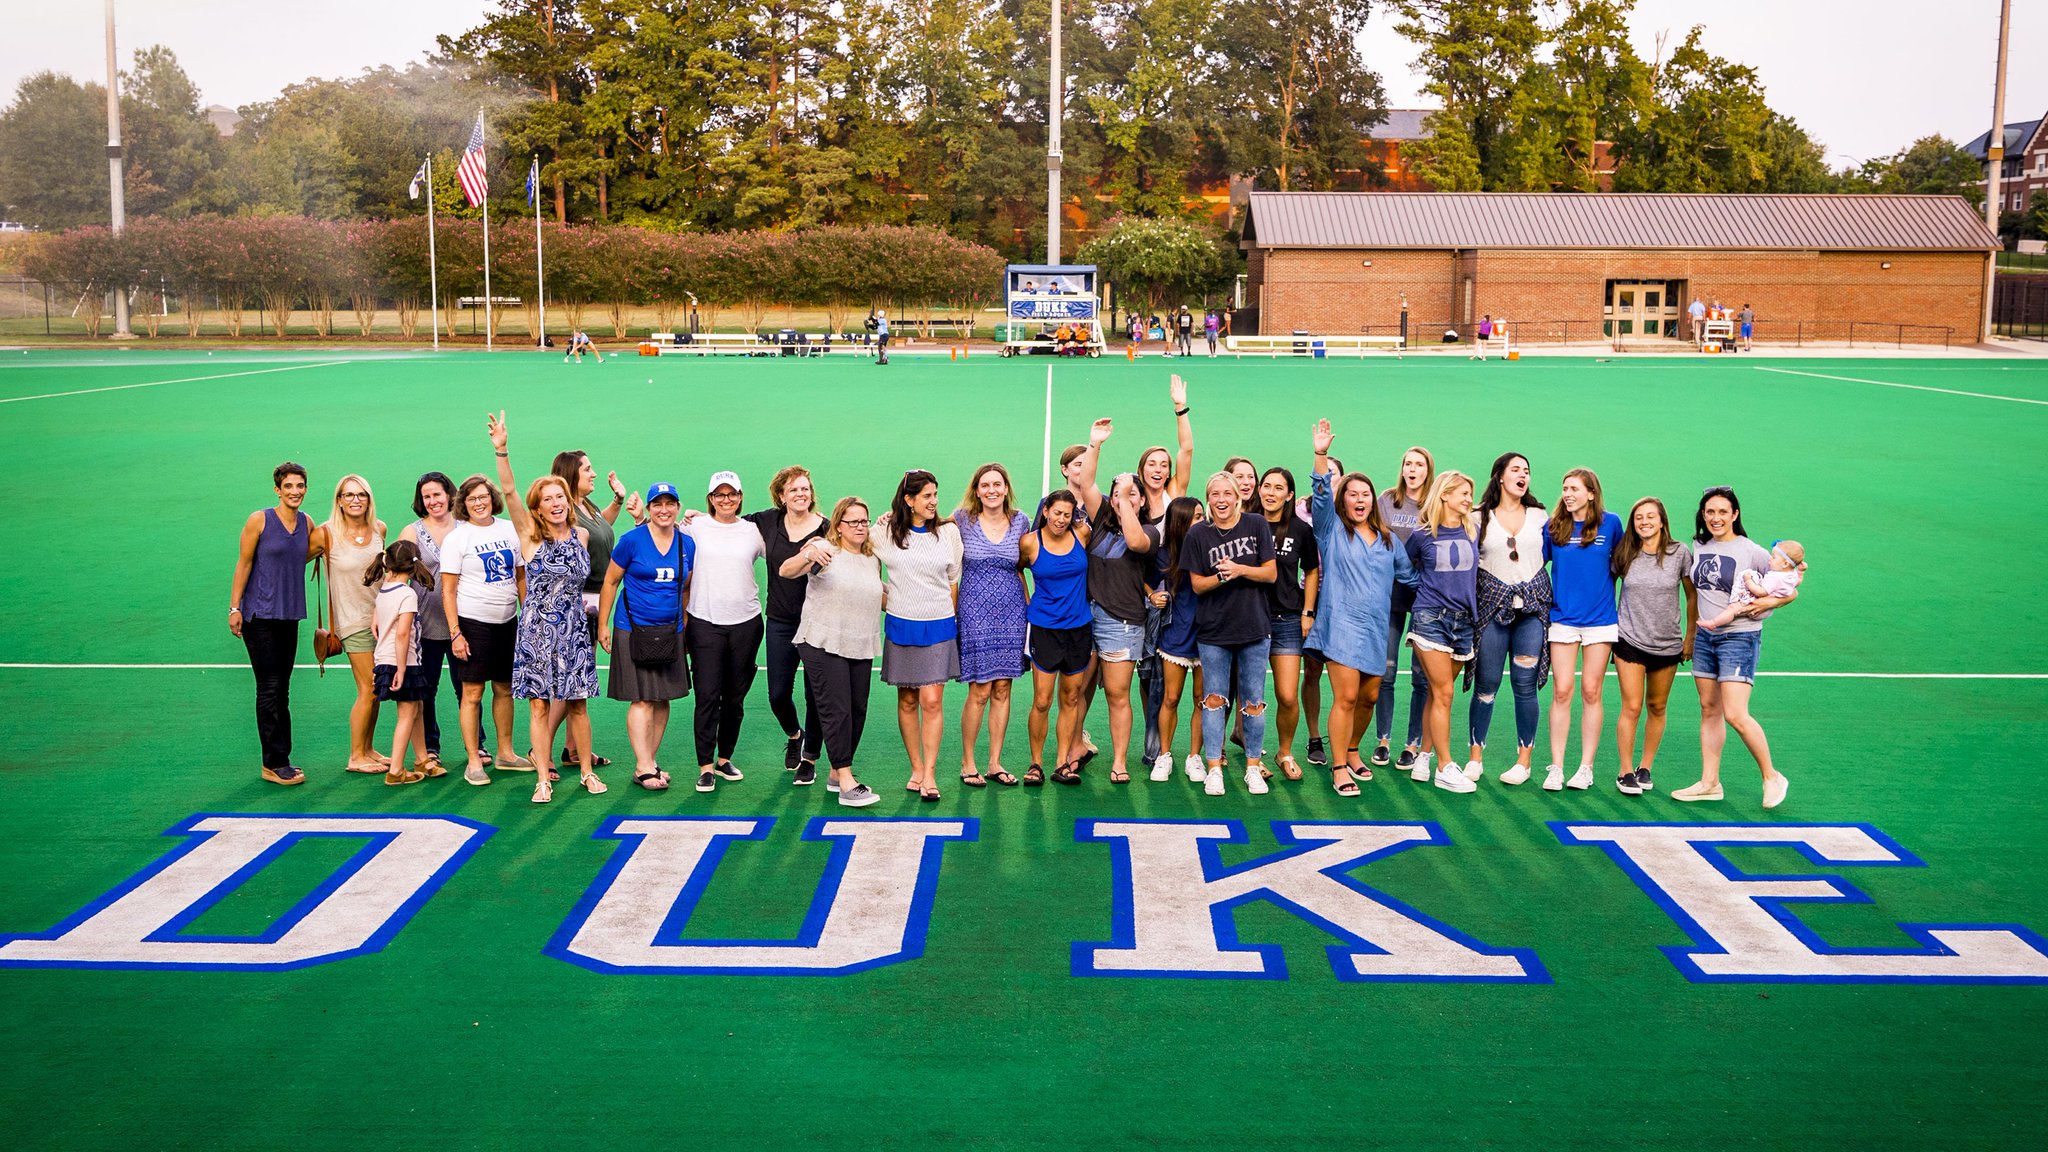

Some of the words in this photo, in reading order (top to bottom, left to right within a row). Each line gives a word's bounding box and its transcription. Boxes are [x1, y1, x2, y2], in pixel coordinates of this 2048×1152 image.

[1034, 301, 1069, 313] DUKE
[1391, 513, 1418, 524] DUK
[474, 539, 511, 553] DUKE
[0, 813, 2048, 984] DUKE
